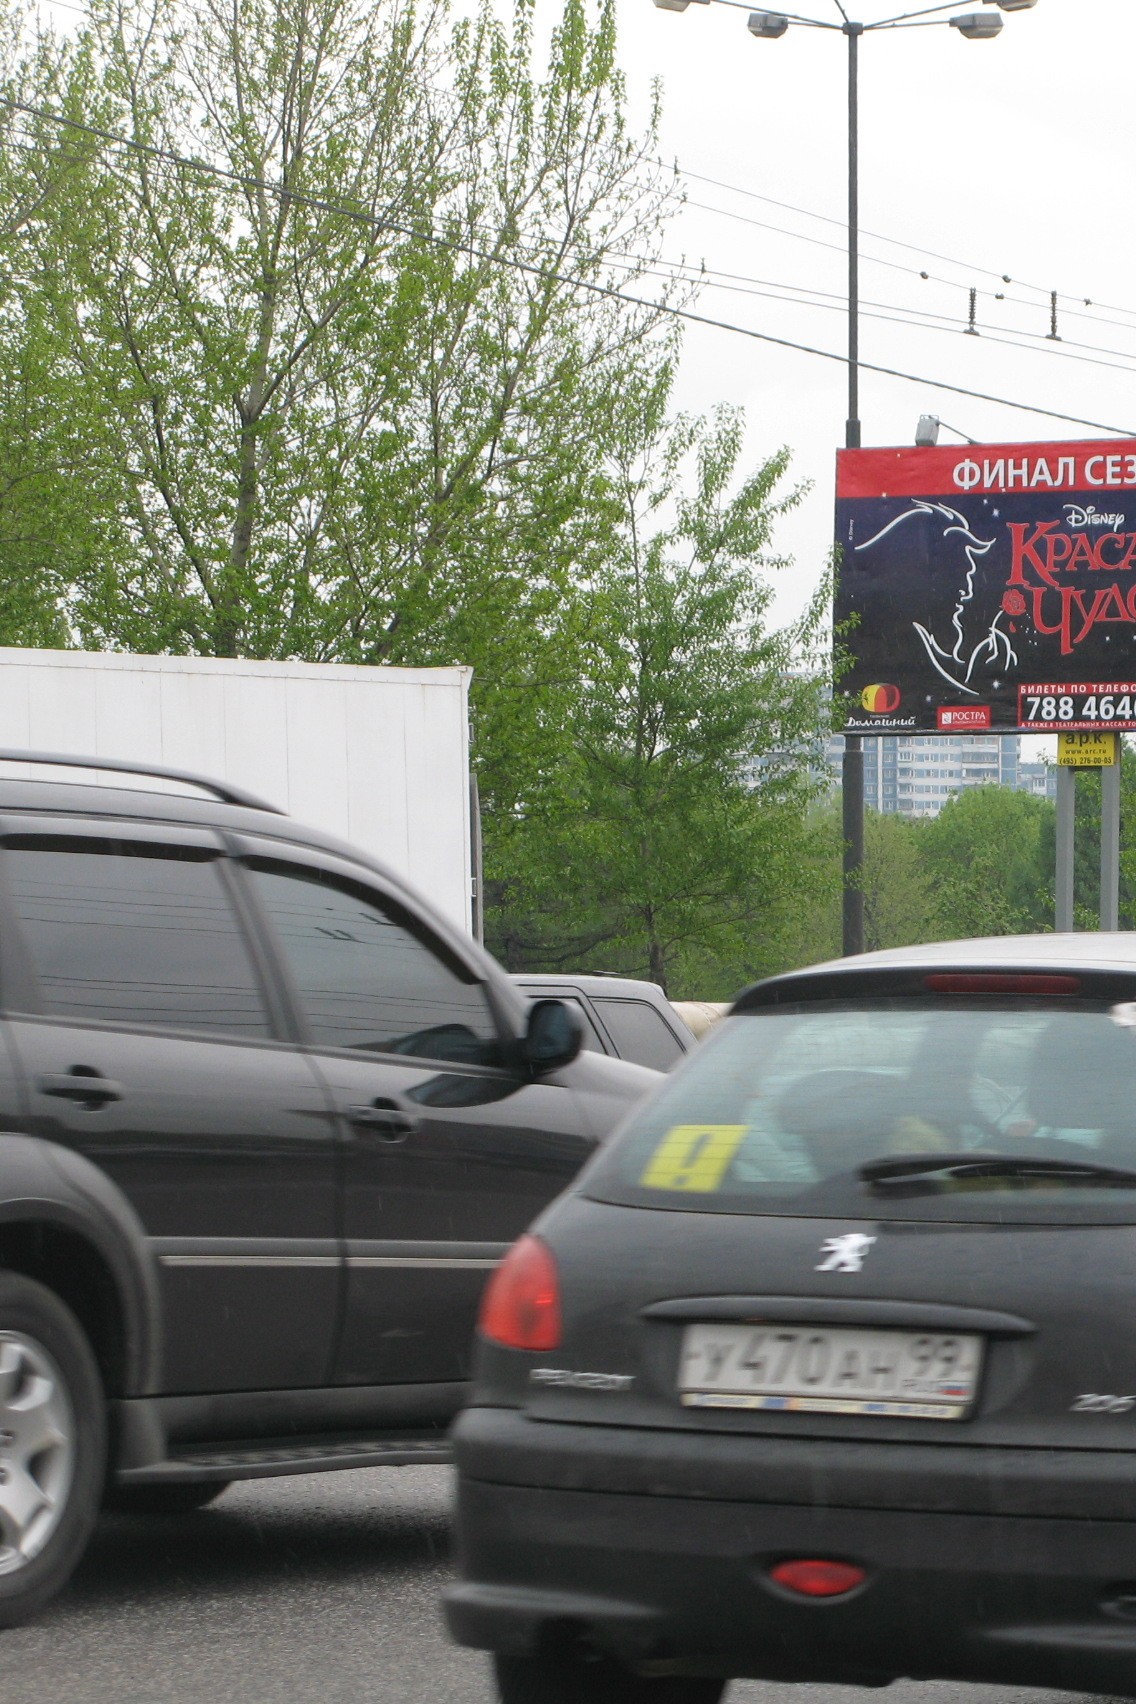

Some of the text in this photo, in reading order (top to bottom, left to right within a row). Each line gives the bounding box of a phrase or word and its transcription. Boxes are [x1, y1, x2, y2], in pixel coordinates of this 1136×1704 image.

[952, 456, 1075, 490] ФИНАЛ
[1020, 685, 1066, 694] БИЛЕТЫ
[1070, 684, 1087, 693] ПО
[952, 711, 986, 720] РОСТРА
[1026, 696, 1074, 720] 788
[907, 1336, 962, 1377] 99
